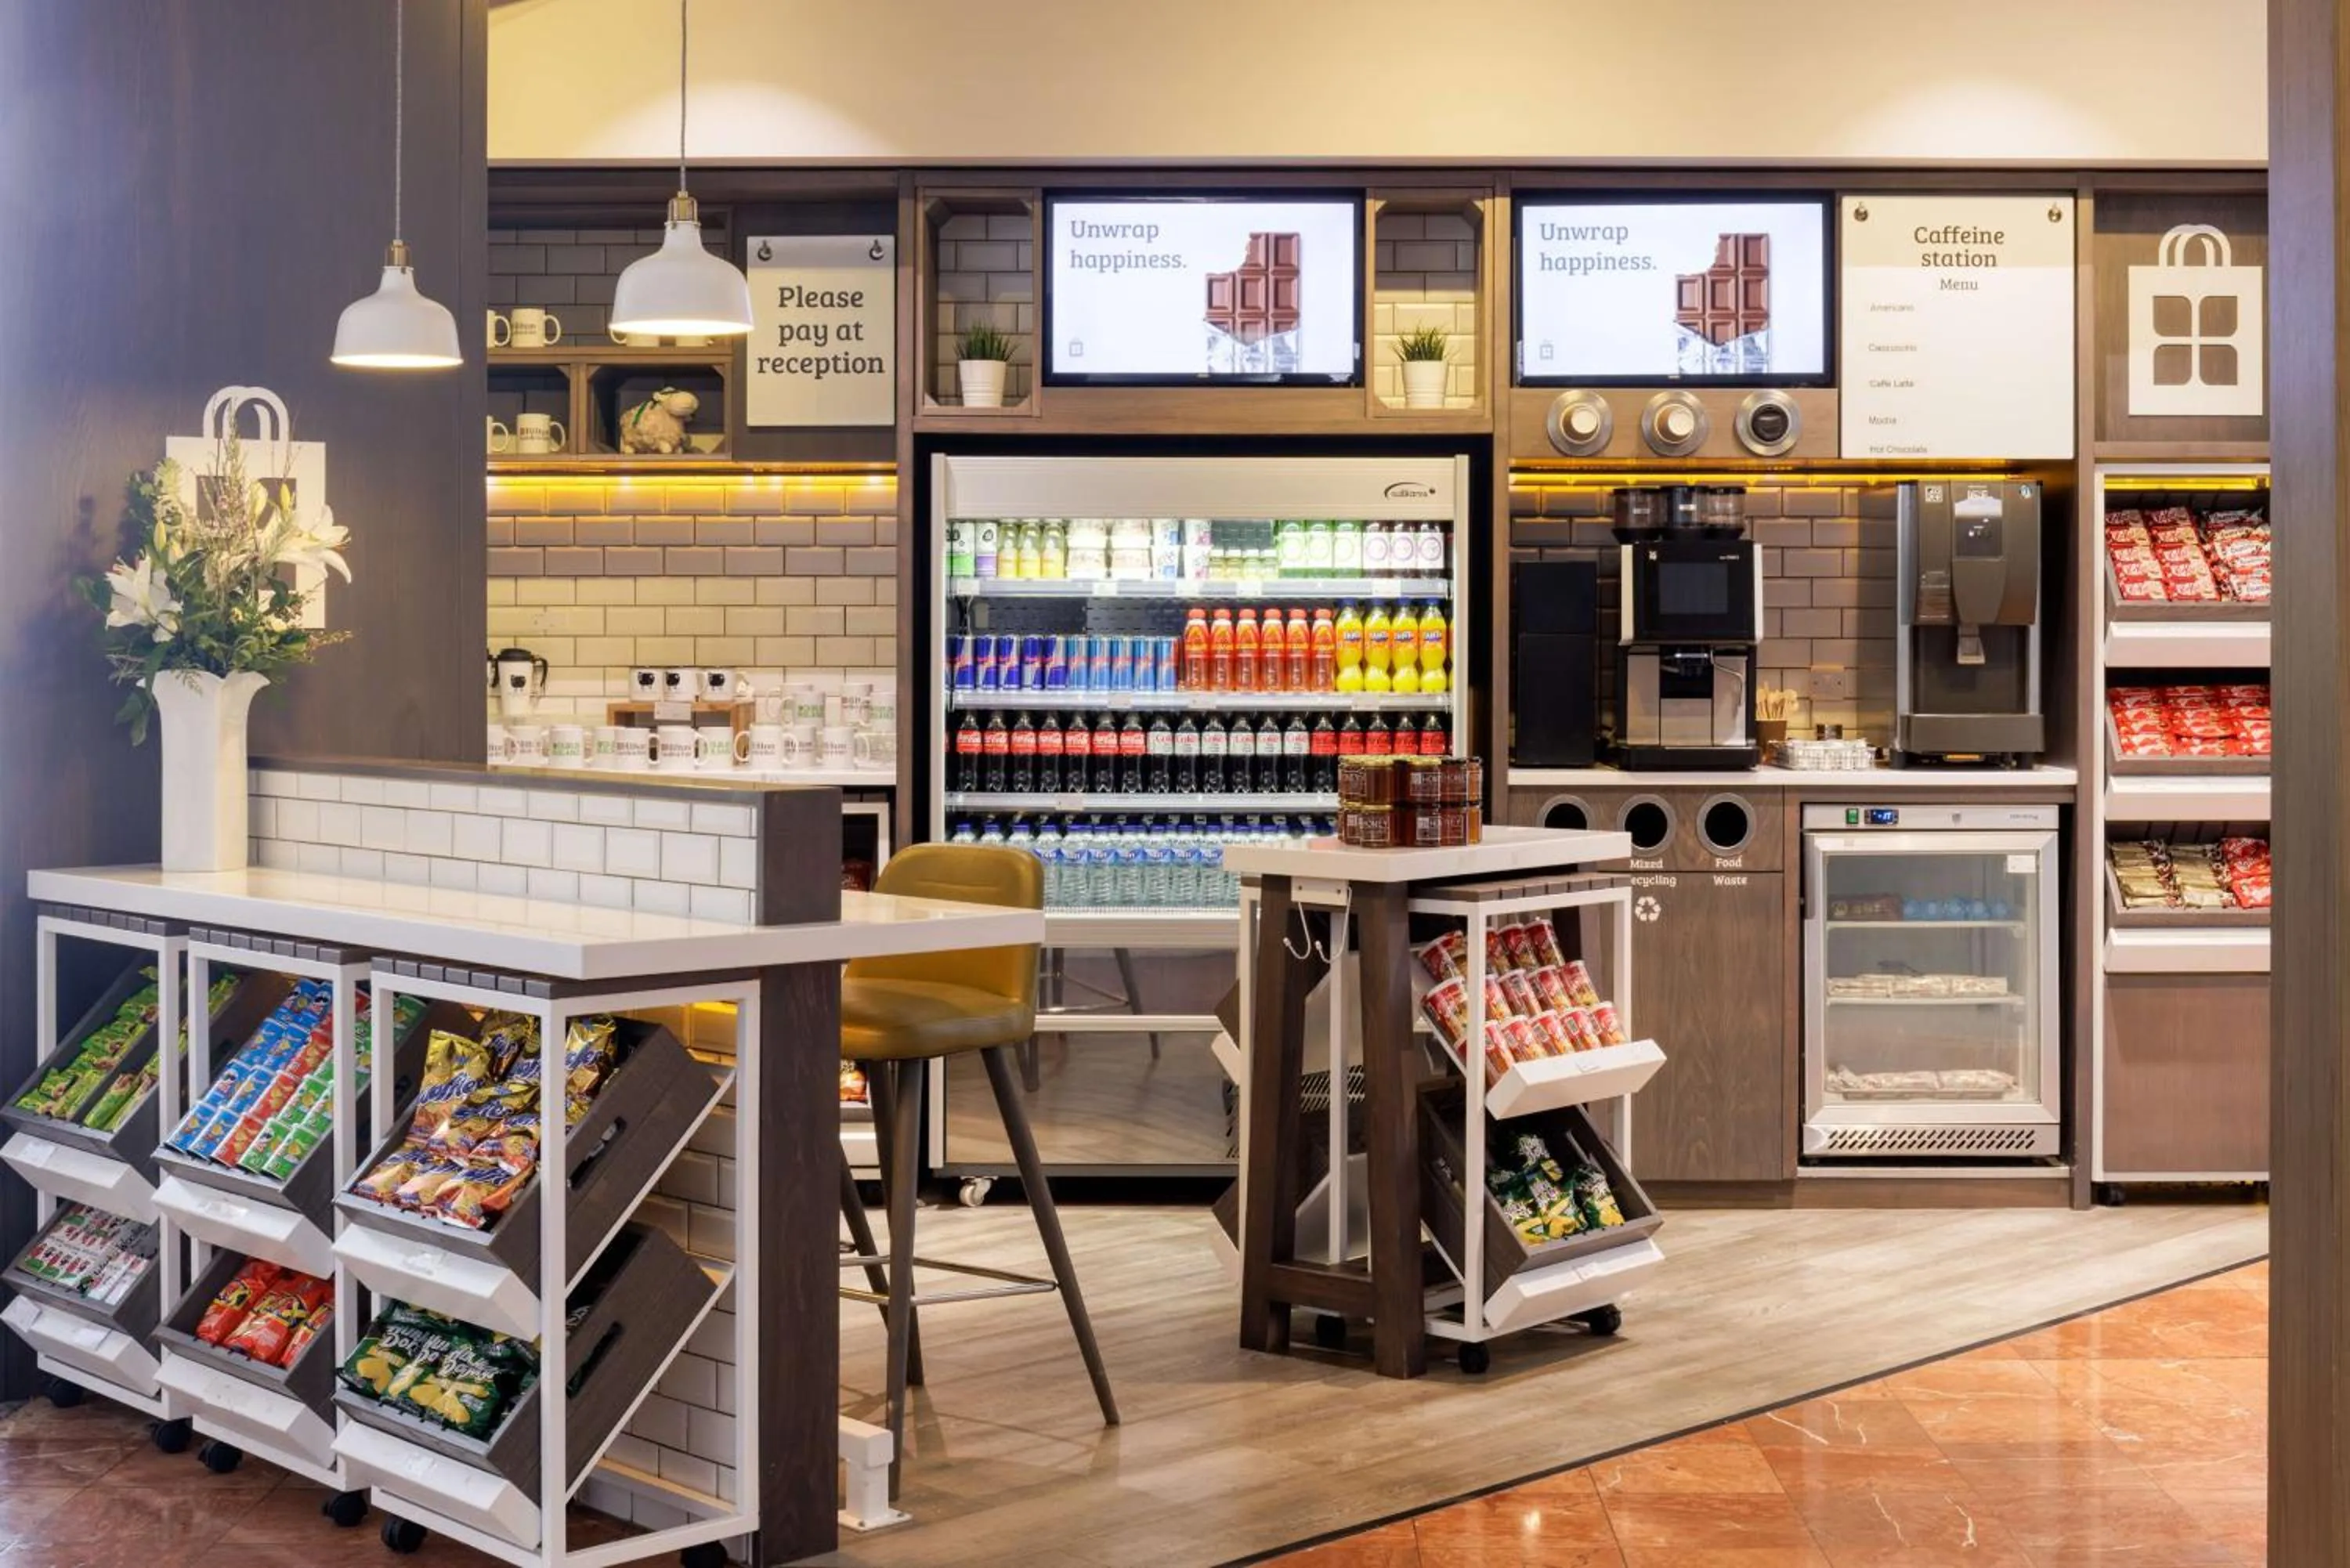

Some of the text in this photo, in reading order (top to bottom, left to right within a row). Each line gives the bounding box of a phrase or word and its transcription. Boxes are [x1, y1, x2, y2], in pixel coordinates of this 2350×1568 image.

[1070, 220, 1159, 244] Unwrap
[1539, 223, 1629, 245] Unwrap
[1914, 226, 2005, 244] Caffeine
[1070, 249, 1188, 274] happiness.
[1539, 251, 1658, 276] happiness.
[1922, 248, 1997, 267] station
[1940, 278, 1979, 291] Menu
[778, 286, 864, 308] Please
[778, 320, 864, 347] pay at
[757, 352, 885, 380] reception
[1630, 858, 1664, 869] Mixed
[1715, 856, 1742, 868] Food
[1630, 875, 1677, 887] ecycling
[1713, 875, 1748, 886] Waste
